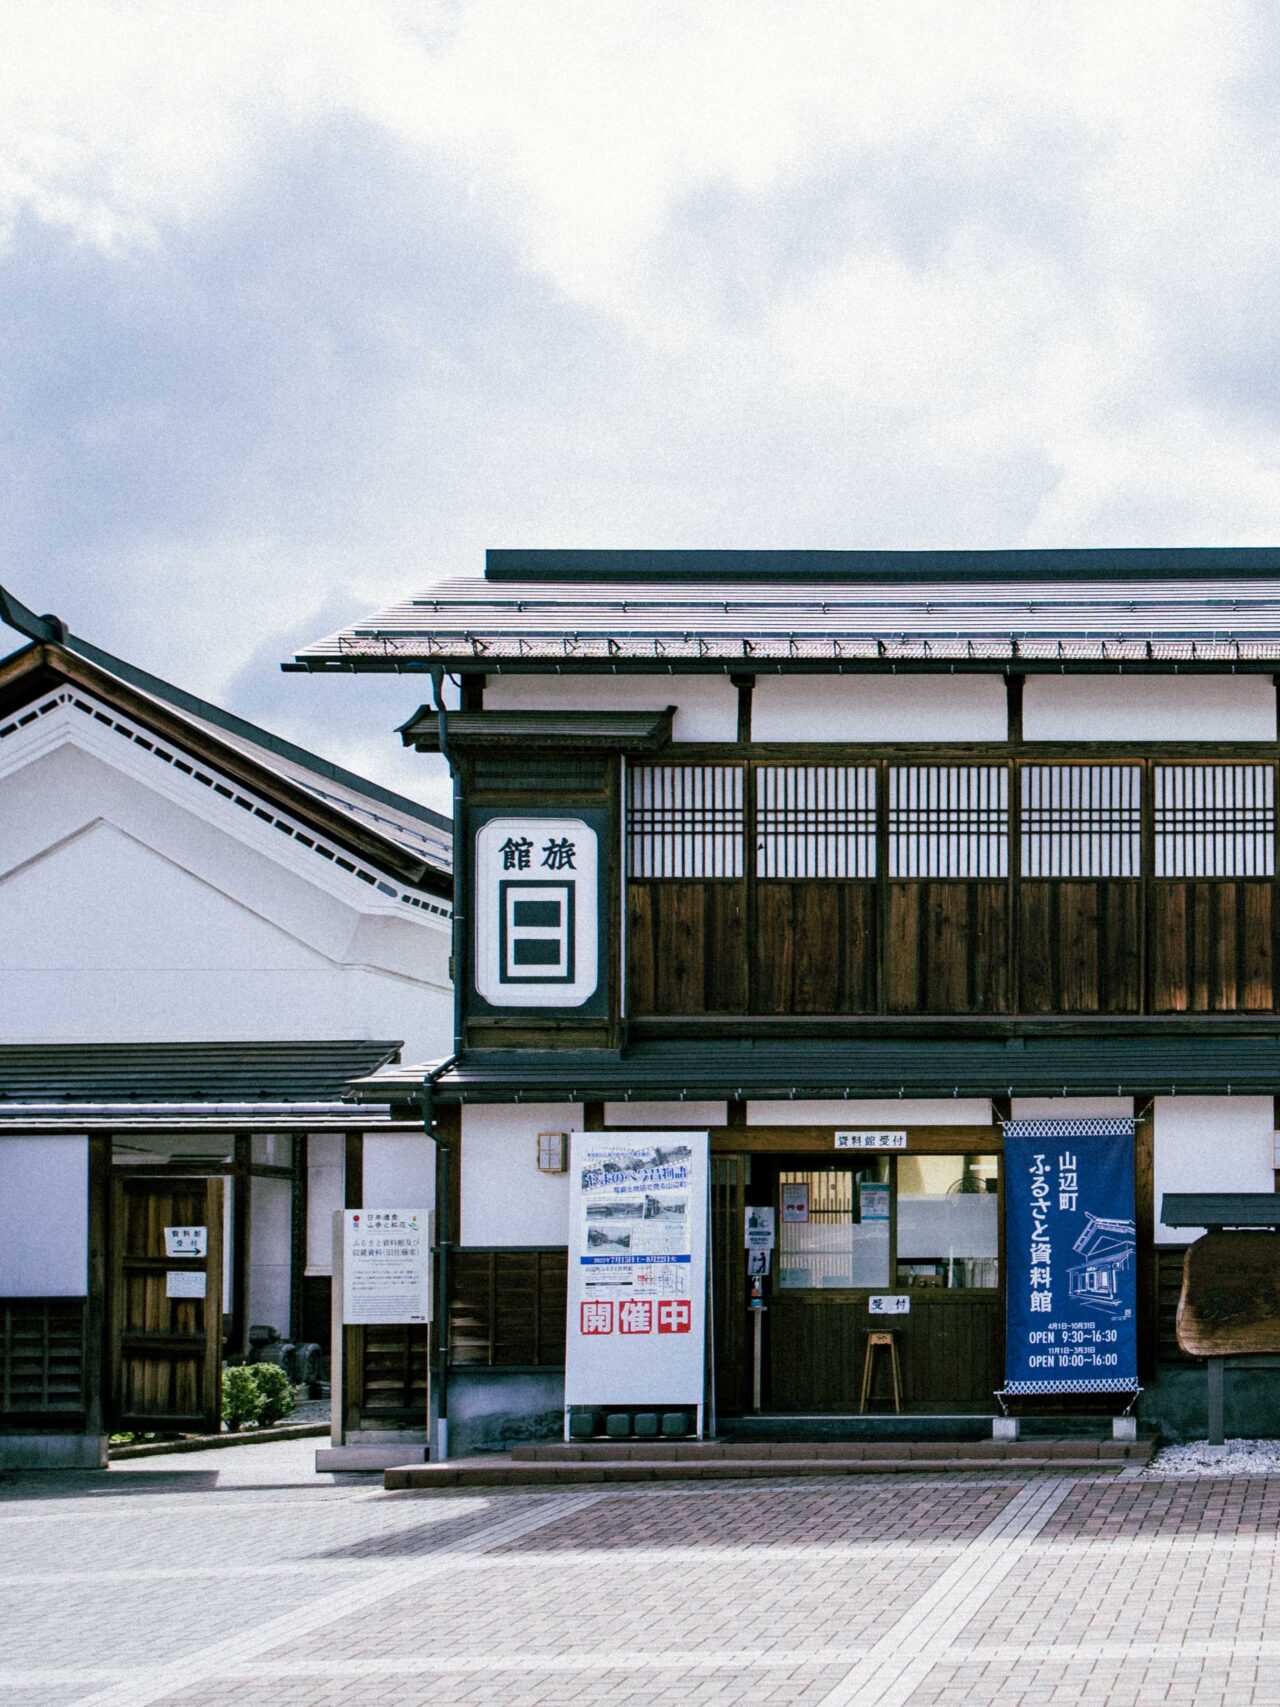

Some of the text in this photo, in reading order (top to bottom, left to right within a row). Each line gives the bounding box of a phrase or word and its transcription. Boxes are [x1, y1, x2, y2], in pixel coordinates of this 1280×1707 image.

[838, 1135, 904, 1147] 資料館受付
[1058, 1151, 1078, 1212] 山辺町
[172, 1230, 201, 1238] 資料館
[1028, 1154, 1052, 1313] ふるさと資料館
[871, 1298, 907, 1311] 受付
[580, 1300, 690, 1335] 開催中
[1029, 1331, 1055, 1344] OPEN
[1029, 1355, 1055, 1368] OPEN
